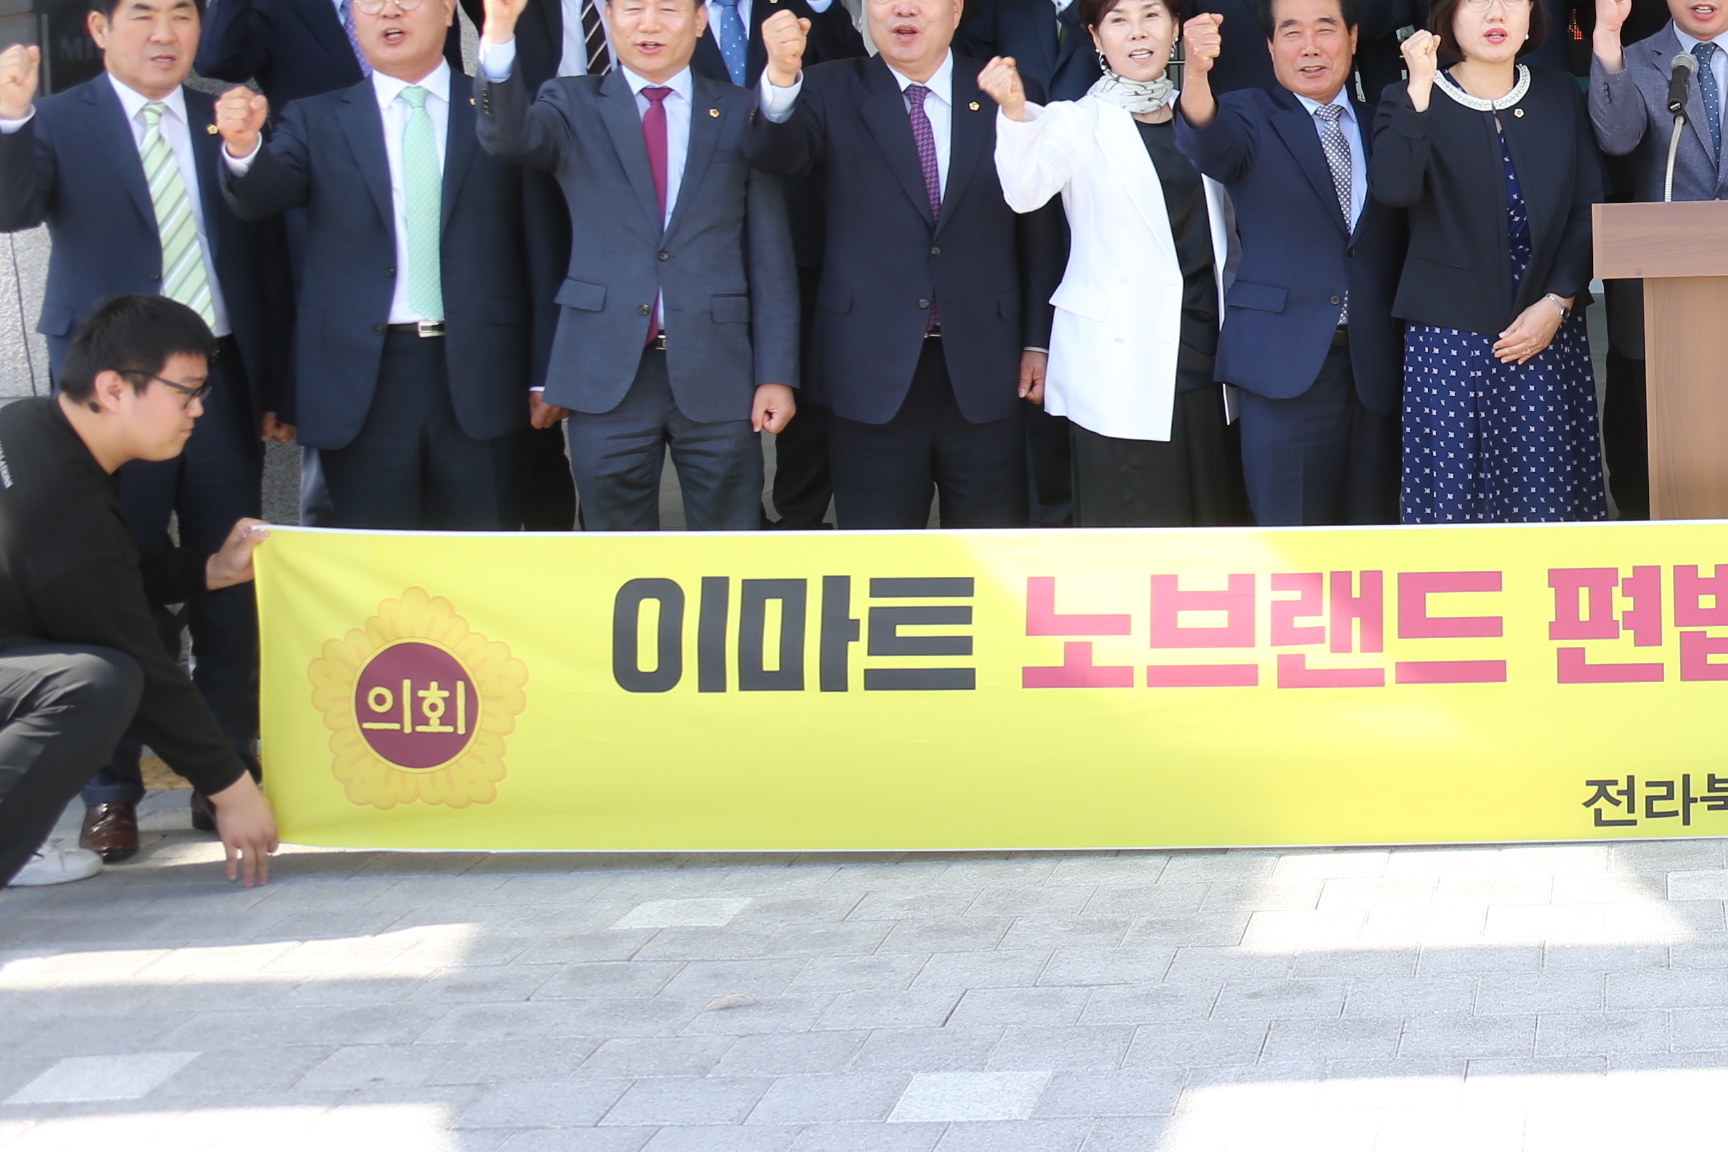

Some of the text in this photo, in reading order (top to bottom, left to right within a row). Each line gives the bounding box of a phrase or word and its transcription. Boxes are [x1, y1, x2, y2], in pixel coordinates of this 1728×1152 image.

[611, 575, 976, 693] 이마트
[1022, 570, 1507, 688] 노브랜드
[362, 678, 467, 735] 의회
